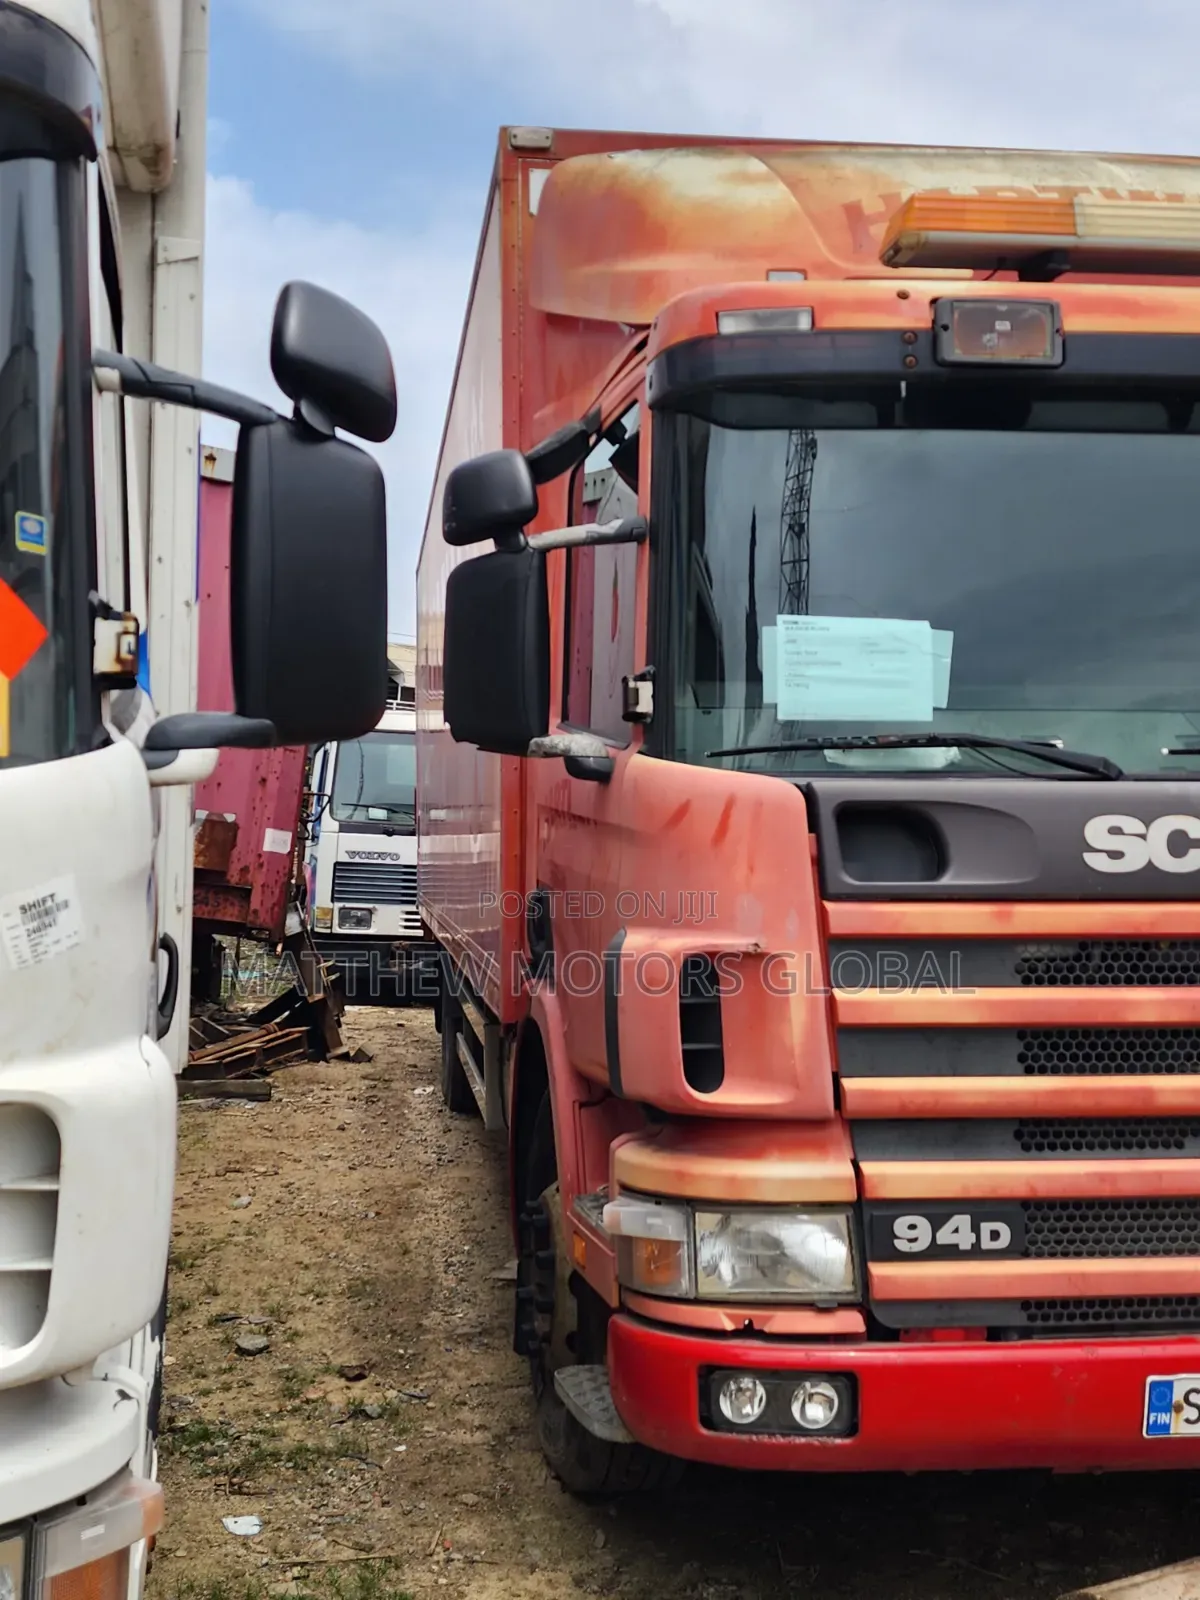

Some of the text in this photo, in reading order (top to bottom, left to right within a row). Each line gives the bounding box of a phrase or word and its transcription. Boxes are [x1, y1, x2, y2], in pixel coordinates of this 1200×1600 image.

[345, 851, 400, 861] VOLVO
[19, 892, 55, 915] SHIFT
[1149, 1411, 1171, 1425] FIN
